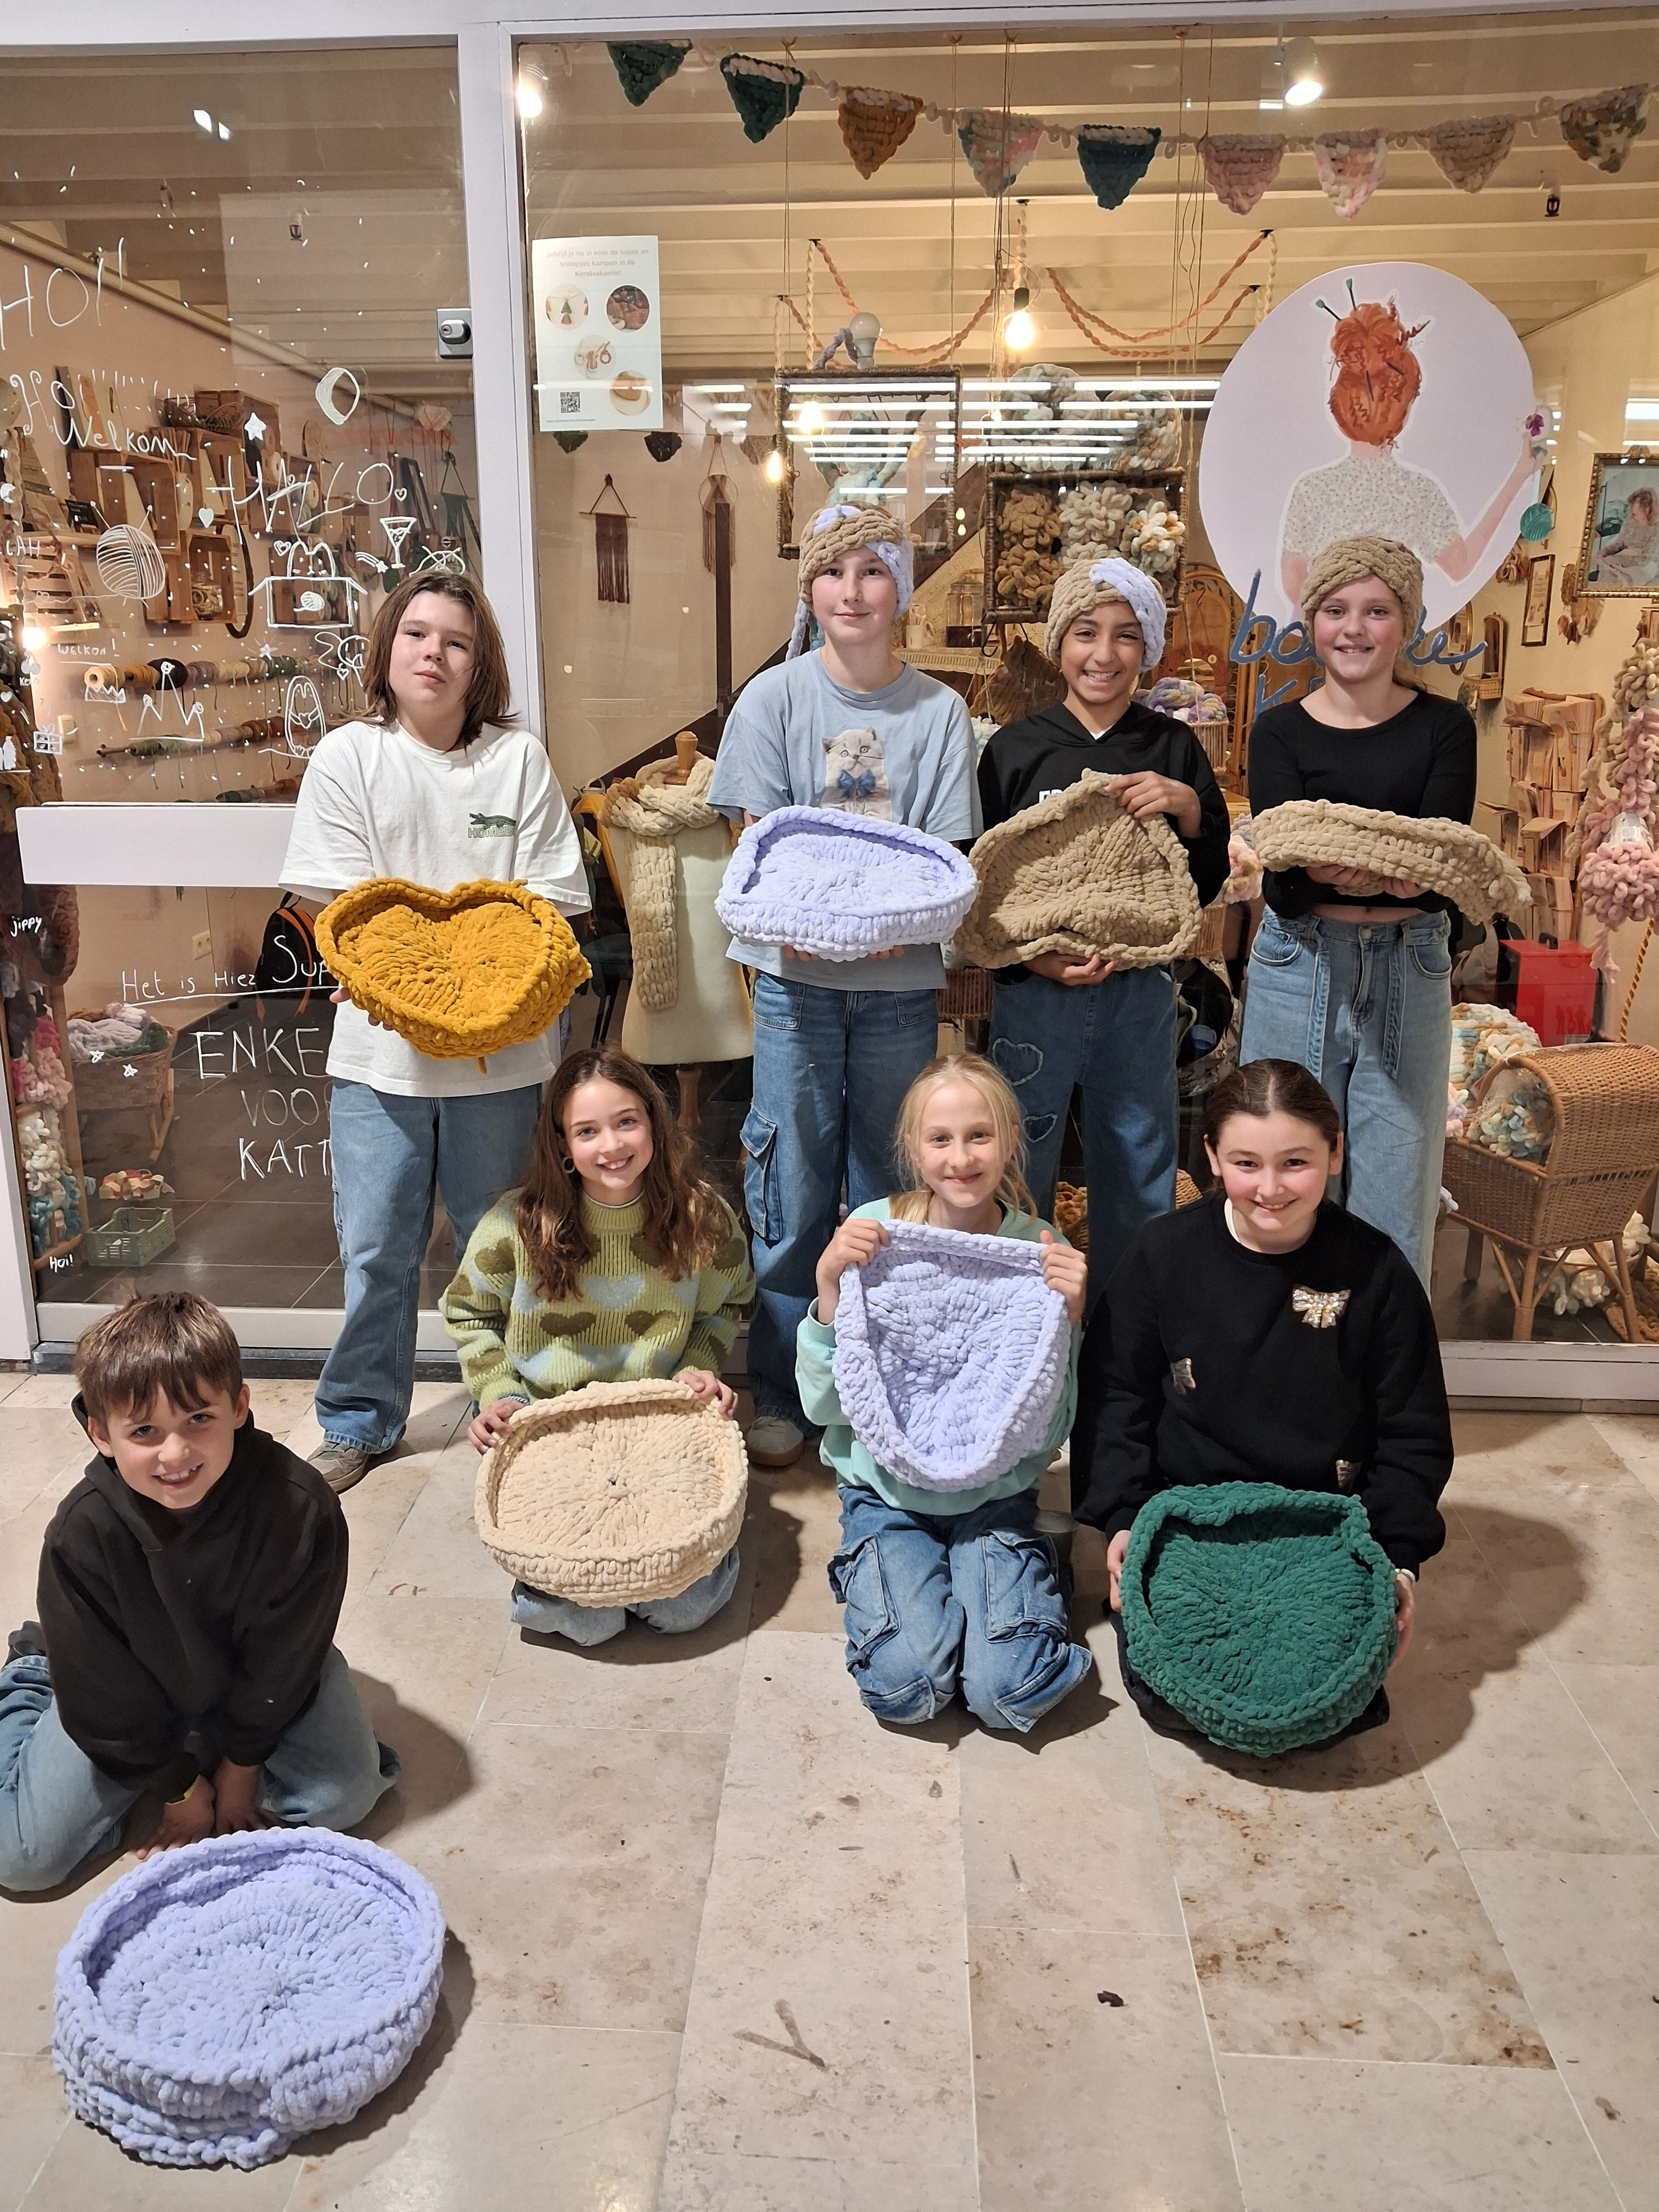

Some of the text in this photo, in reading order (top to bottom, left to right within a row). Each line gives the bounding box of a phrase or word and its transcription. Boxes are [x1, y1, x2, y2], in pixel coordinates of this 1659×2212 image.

[121, 969, 165, 1002] Het
[180, 975, 196, 994] is
[194, 1026, 333, 1080] ENKE
